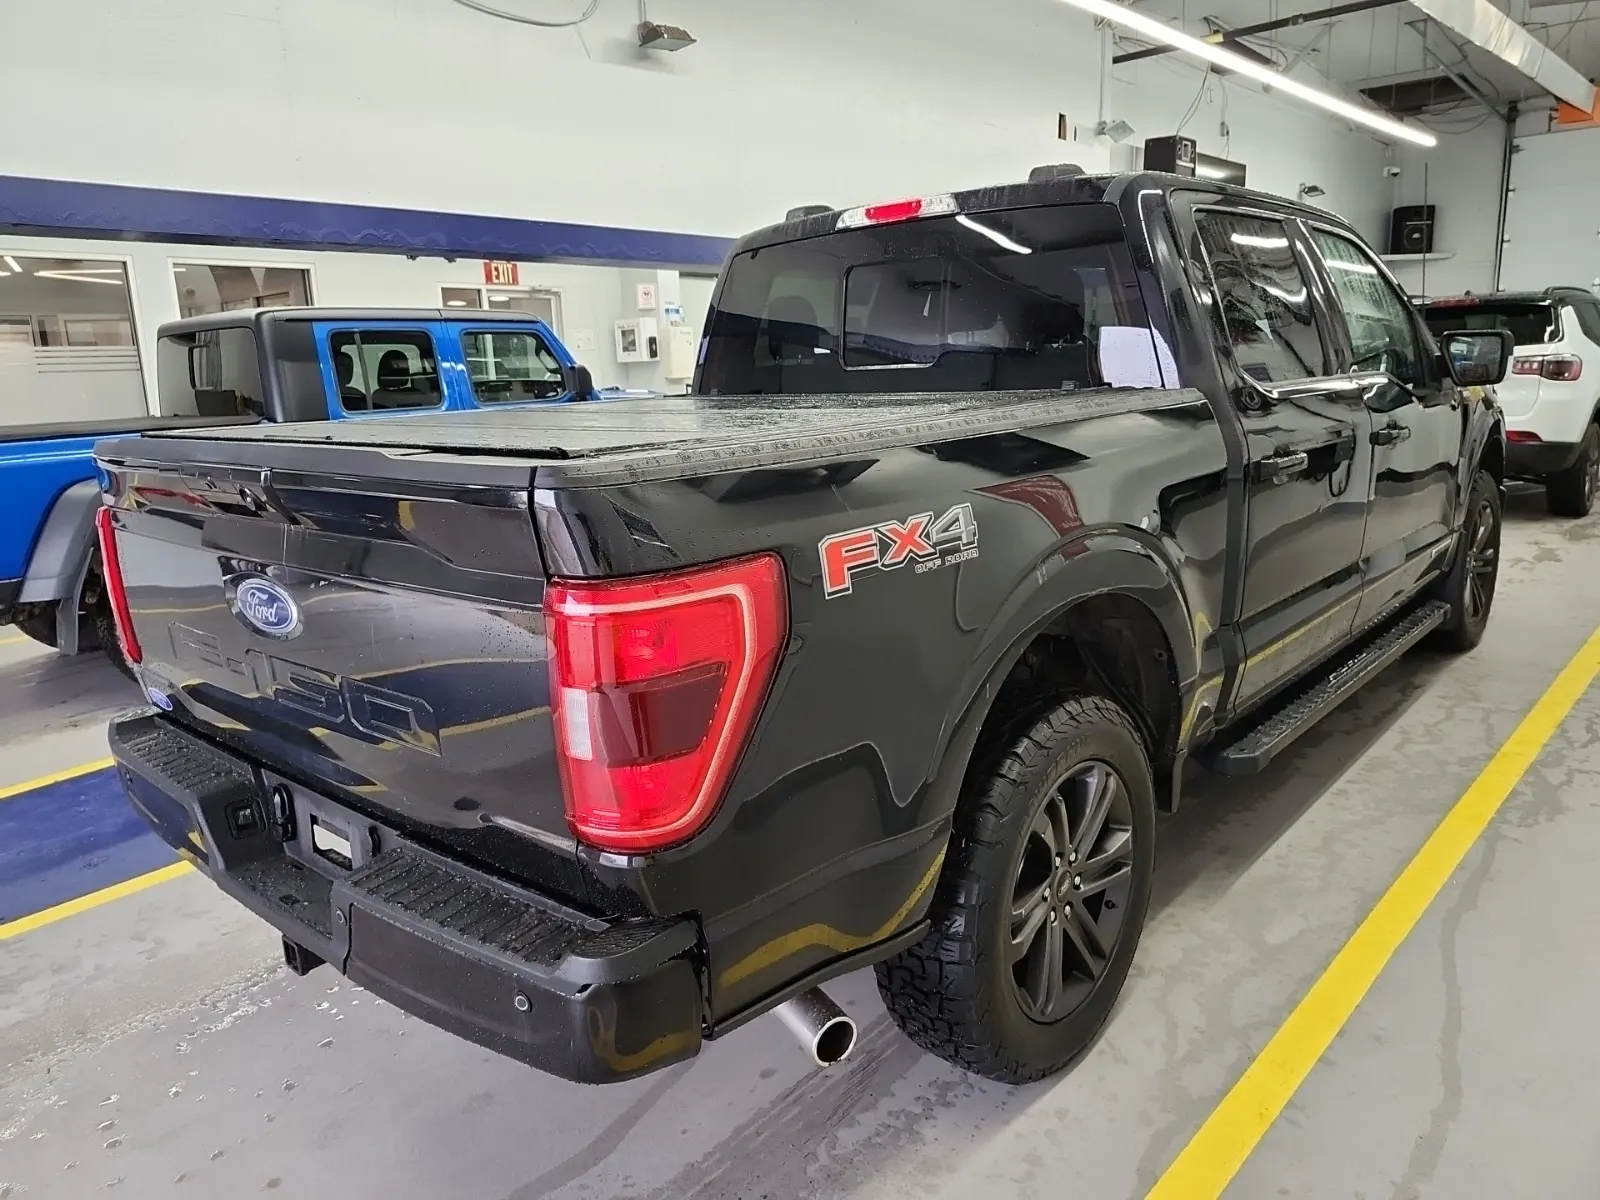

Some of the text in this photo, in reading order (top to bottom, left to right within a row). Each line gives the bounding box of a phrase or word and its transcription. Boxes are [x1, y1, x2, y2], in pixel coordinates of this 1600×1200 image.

[491, 263, 514, 284] EXIT
[818, 503, 978, 599] FX4
[915, 549, 979, 573] OFF ROAD
[246, 589, 279, 623] Ford
